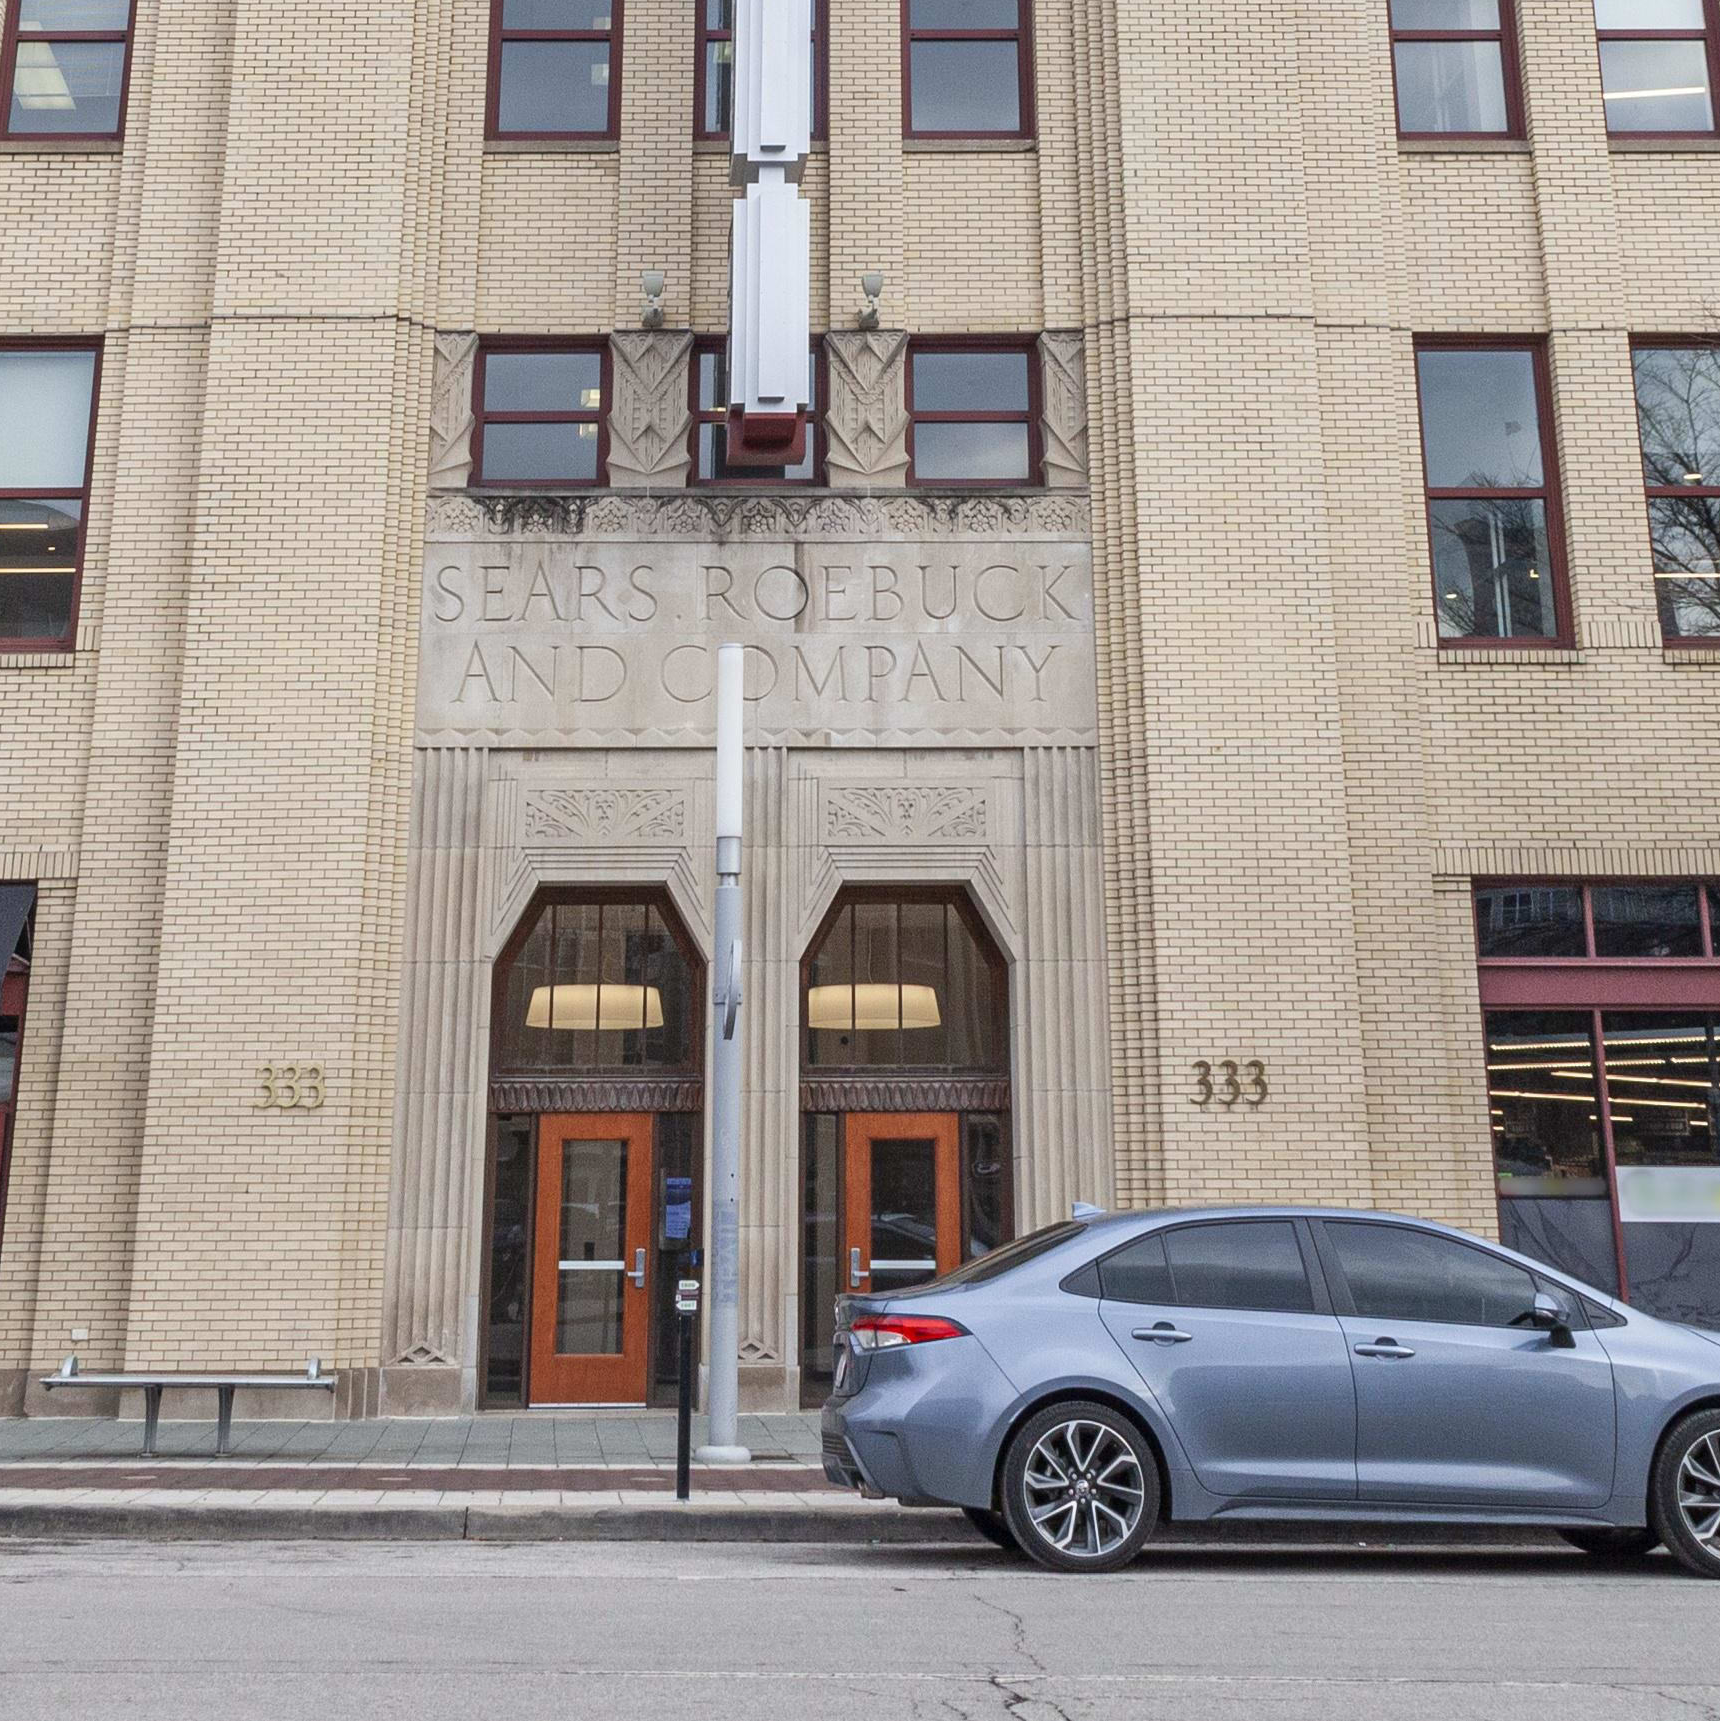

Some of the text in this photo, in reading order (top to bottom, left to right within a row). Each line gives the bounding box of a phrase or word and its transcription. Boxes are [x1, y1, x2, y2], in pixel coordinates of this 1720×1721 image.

[699, 564, 1083, 622] ROEBUCK
[448, 639, 1063, 704] AND COMPANY
[254, 1063, 328, 1110] 333
[1189, 1059, 1269, 1106] 333
